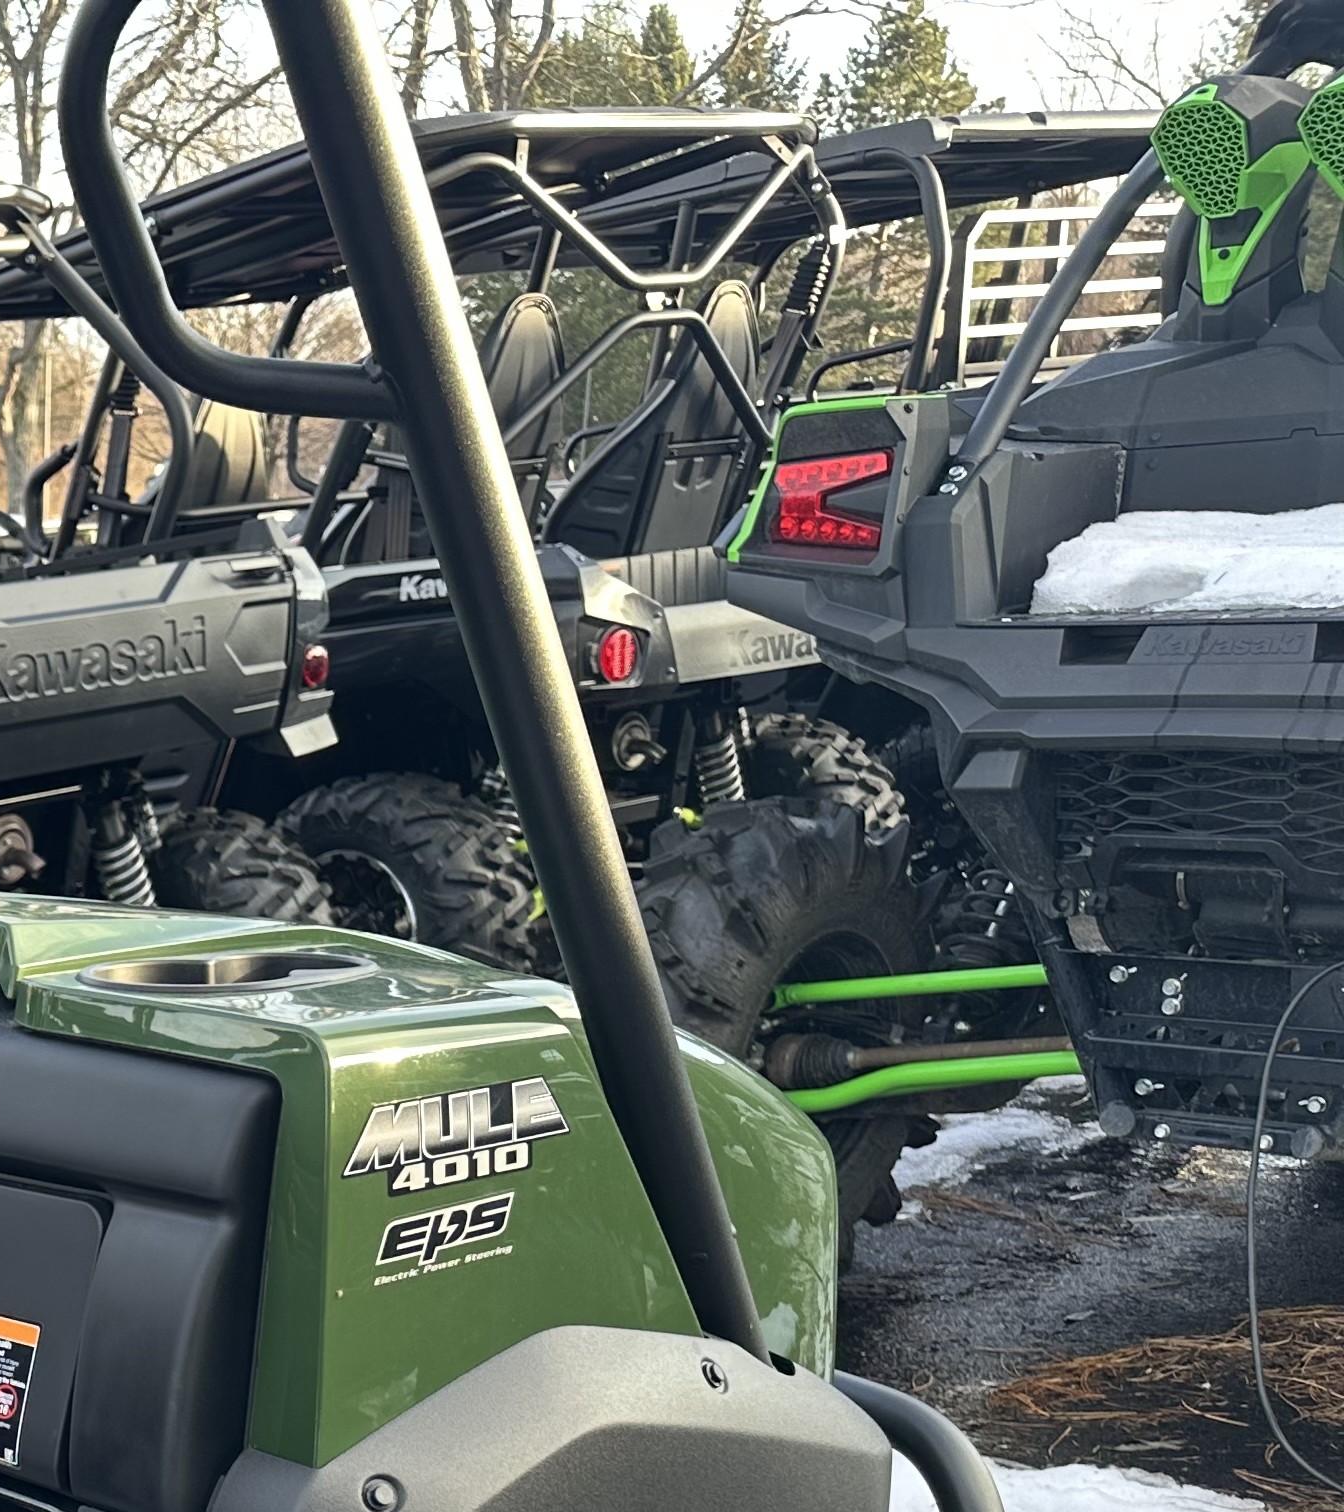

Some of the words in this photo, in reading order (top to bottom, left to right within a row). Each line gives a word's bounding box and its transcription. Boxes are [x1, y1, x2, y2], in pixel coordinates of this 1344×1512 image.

[727, 629, 814, 667] Kawa
[343, 1077, 570, 1177] MULE
[392, 1142, 529, 1191] 4010
[375, 1192, 515, 1266] EPS
[374, 1268, 419, 1286] Electric
[423, 1258, 461, 1274] Power
[464, 1245, 513, 1264] Steering
